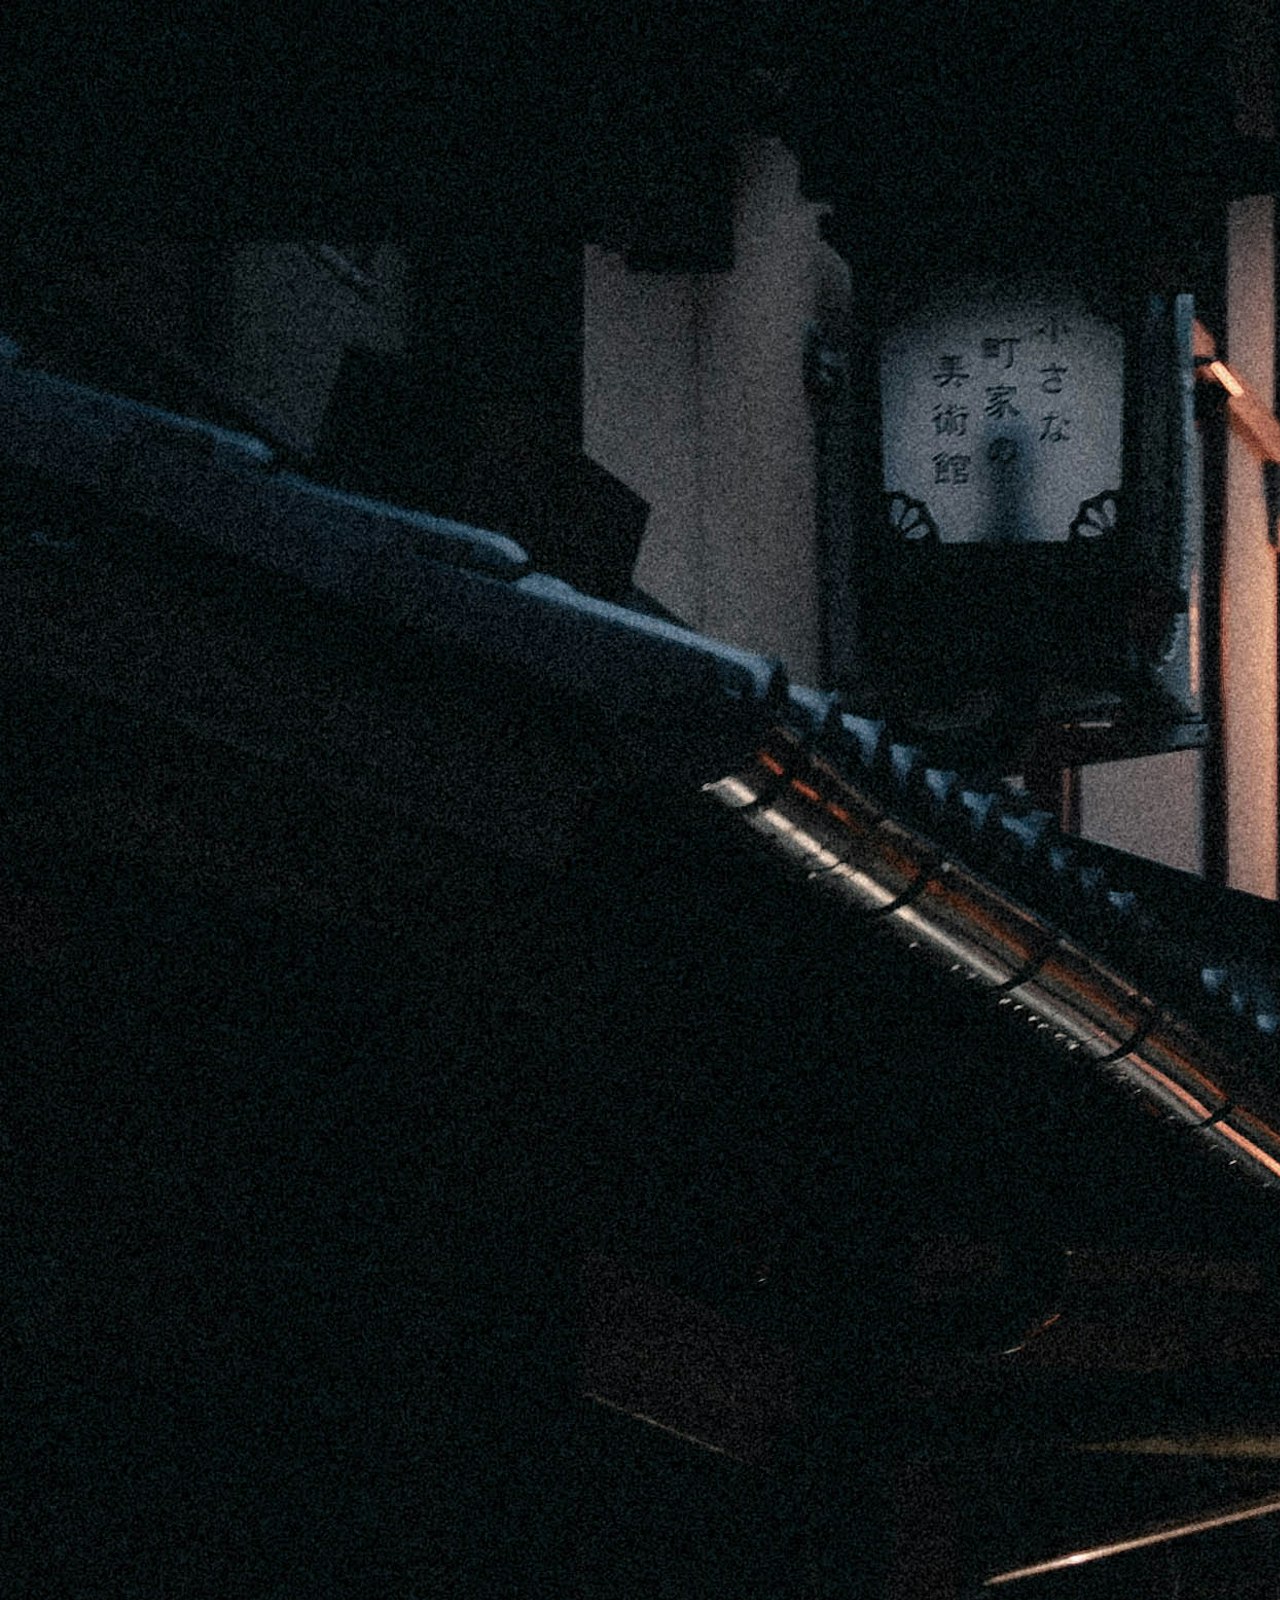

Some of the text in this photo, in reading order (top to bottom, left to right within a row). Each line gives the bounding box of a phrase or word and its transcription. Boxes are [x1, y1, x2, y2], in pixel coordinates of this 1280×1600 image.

[932, 354, 972, 485] 美術館
[981, 337, 1021, 465] 町家の
[1034, 315, 1072, 443] 小さな
